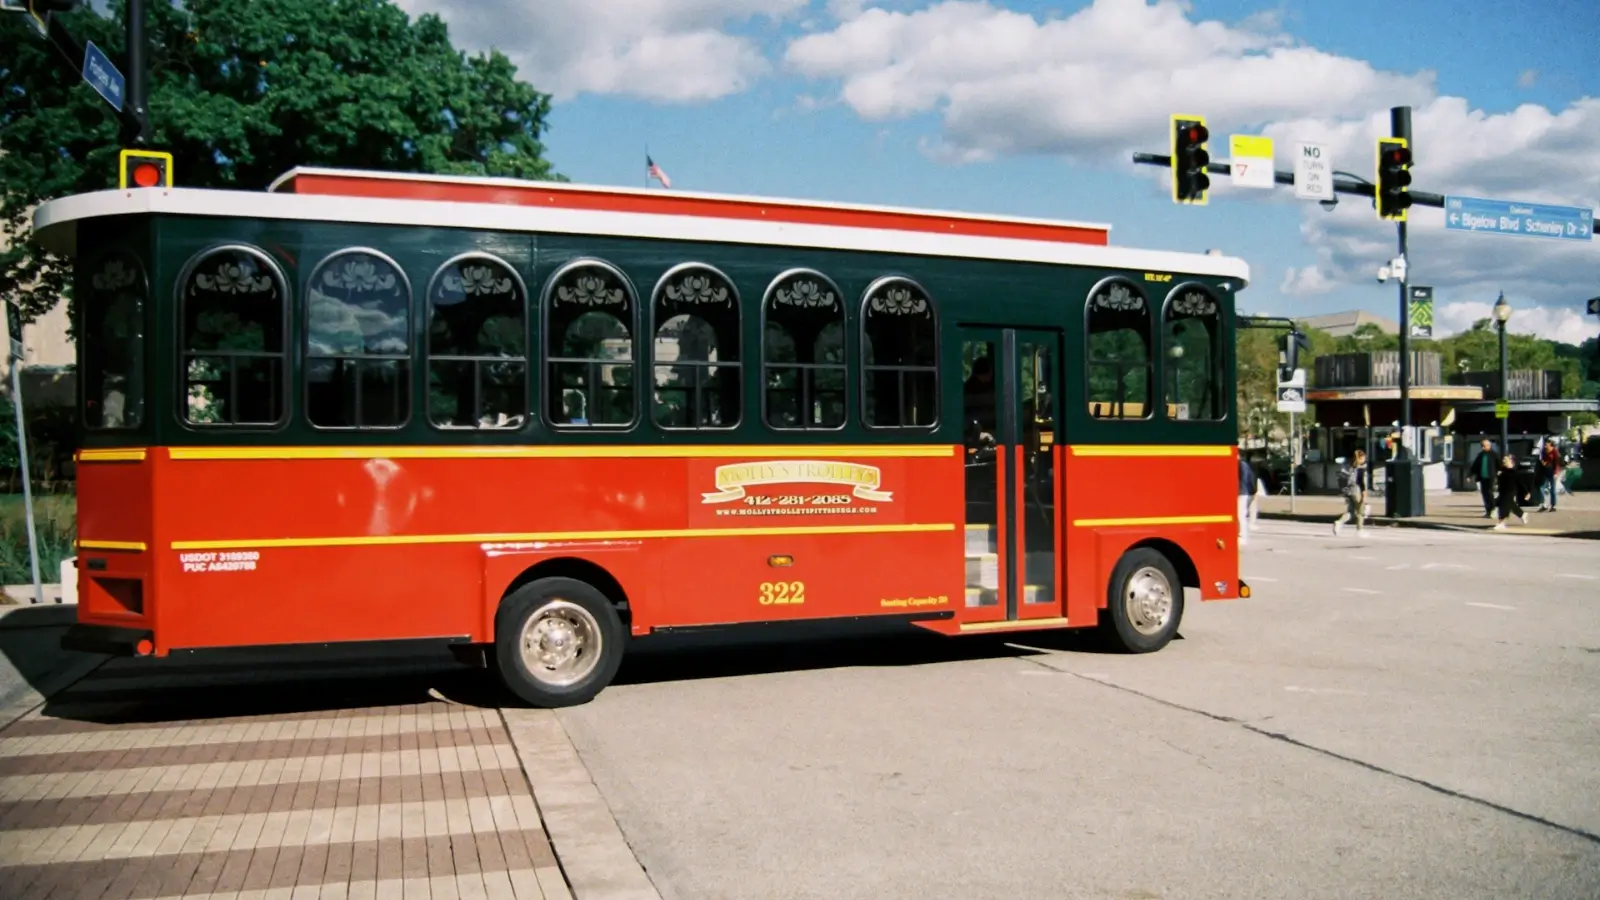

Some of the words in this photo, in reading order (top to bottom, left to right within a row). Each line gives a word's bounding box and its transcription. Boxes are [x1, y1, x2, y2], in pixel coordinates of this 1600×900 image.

[1304, 146, 1321, 159] NO
[1303, 160, 1324, 171] TURN
[1308, 172, 1320, 182] ON
[1307, 184, 1323, 194] RED
[1462, 212, 1497, 231] Bigelow
[1499, 216, 1519, 231] Blvd
[1525, 219, 1564, 237] Schenley
[1567, 222, 1577, 236] Dr
[743, 494, 852, 506] 412-281-2085
[180, 552, 217, 563] USDOT
[183, 562, 207, 572] PUC
[759, 581, 805, 605] 322
[908, 596, 938, 606] Capacity
